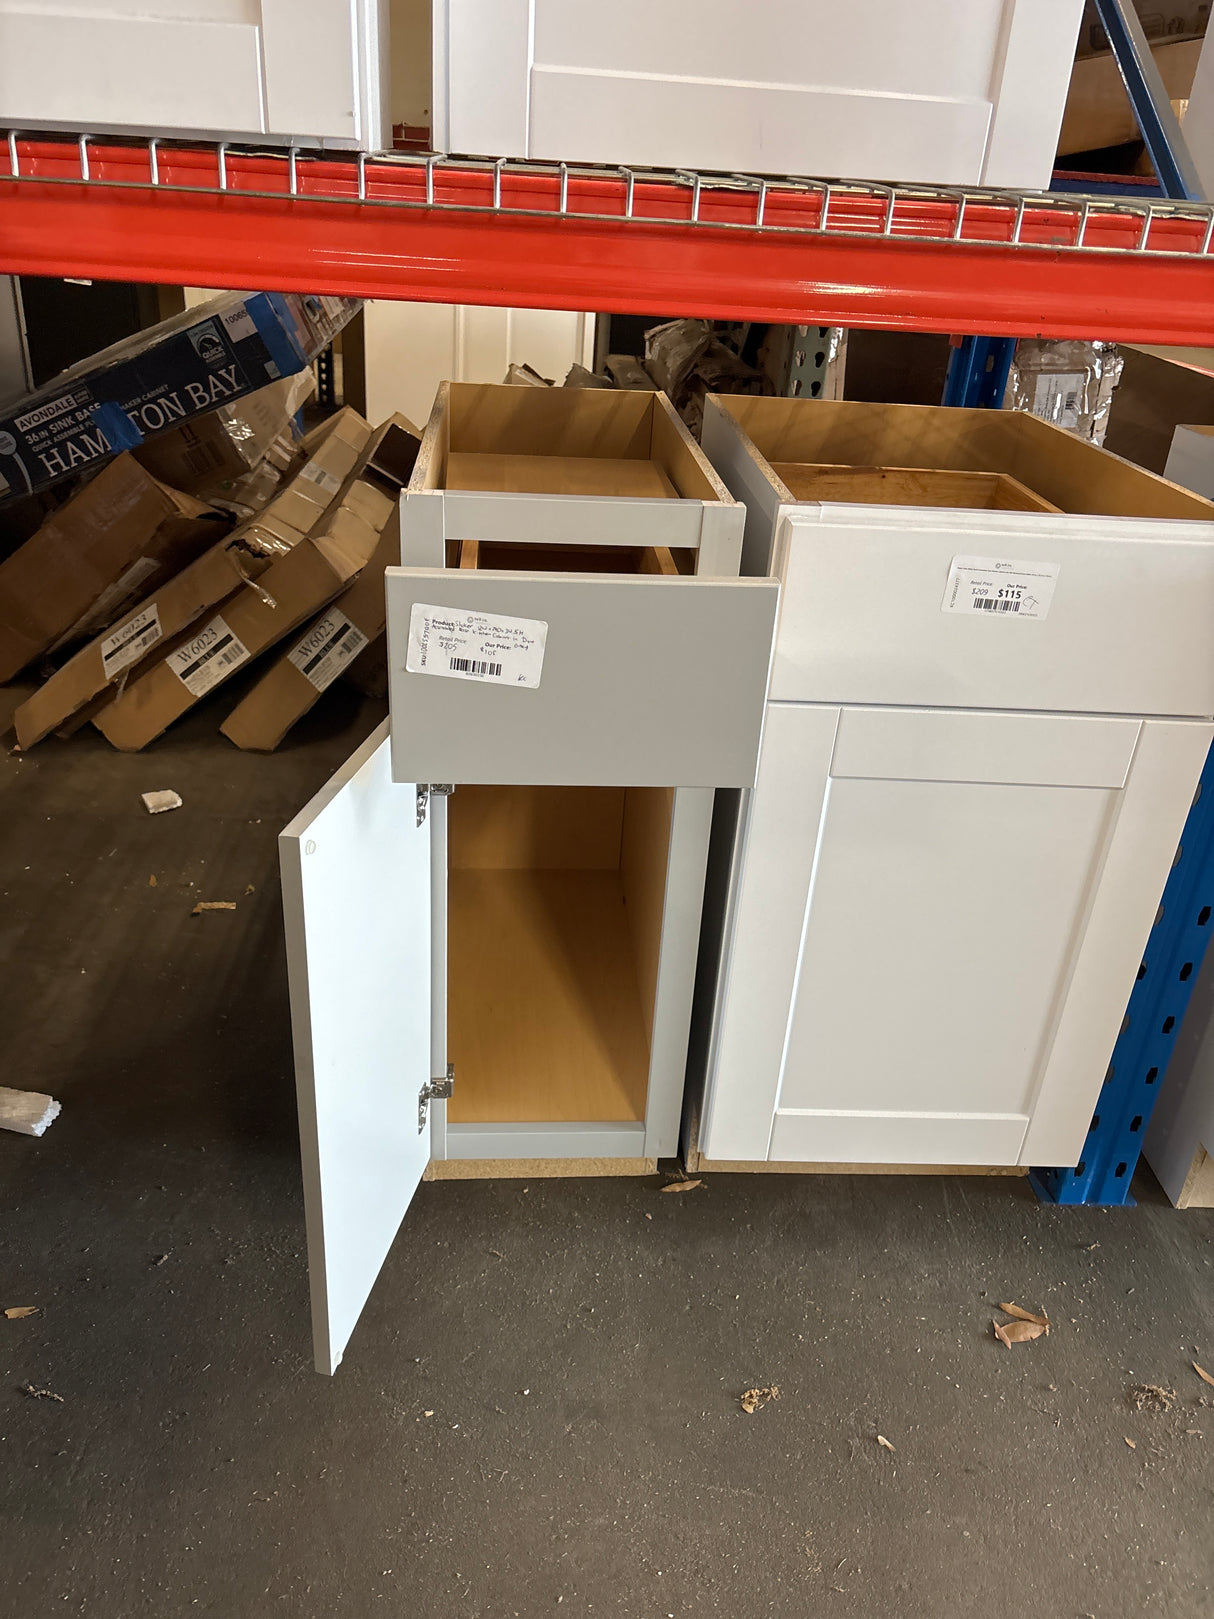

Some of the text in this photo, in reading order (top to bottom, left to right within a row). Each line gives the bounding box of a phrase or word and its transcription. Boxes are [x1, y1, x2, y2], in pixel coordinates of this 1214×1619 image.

[19, 397, 75, 430] AVONDALE
[38, 364, 242, 478] HAMTON BAY
[49, 415, 76, 434] SINK
[971, 587, 989, 596] $209
[998, 588, 1022, 600] $115
[110, 613, 147, 645] W6023
[177, 627, 218, 662] W6023
[298, 619, 335, 657] W6023
